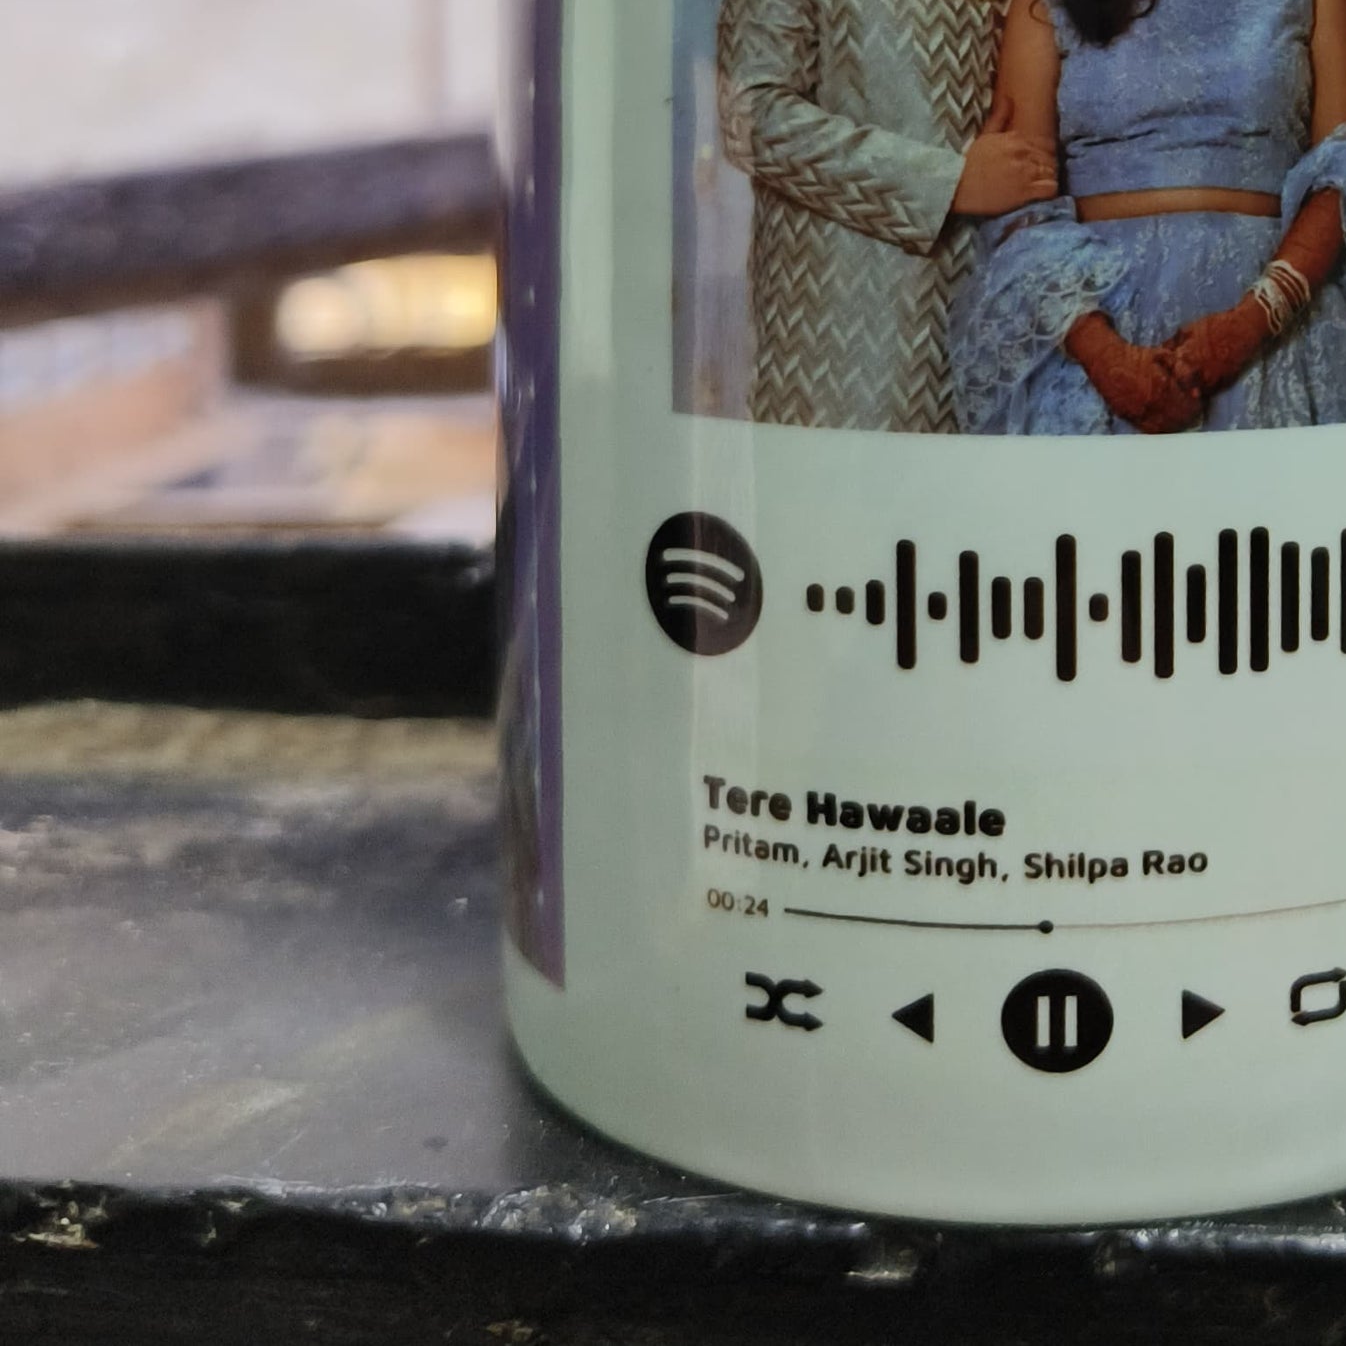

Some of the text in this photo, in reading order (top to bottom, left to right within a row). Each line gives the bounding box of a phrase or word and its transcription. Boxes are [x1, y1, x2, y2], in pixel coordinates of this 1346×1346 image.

[703, 774, 1006, 837] Tere Hawaale
[704, 824, 1209, 885] Pritam, Arjit Singh, Shilpa Rao
[707, 888, 769, 918] 00:24
